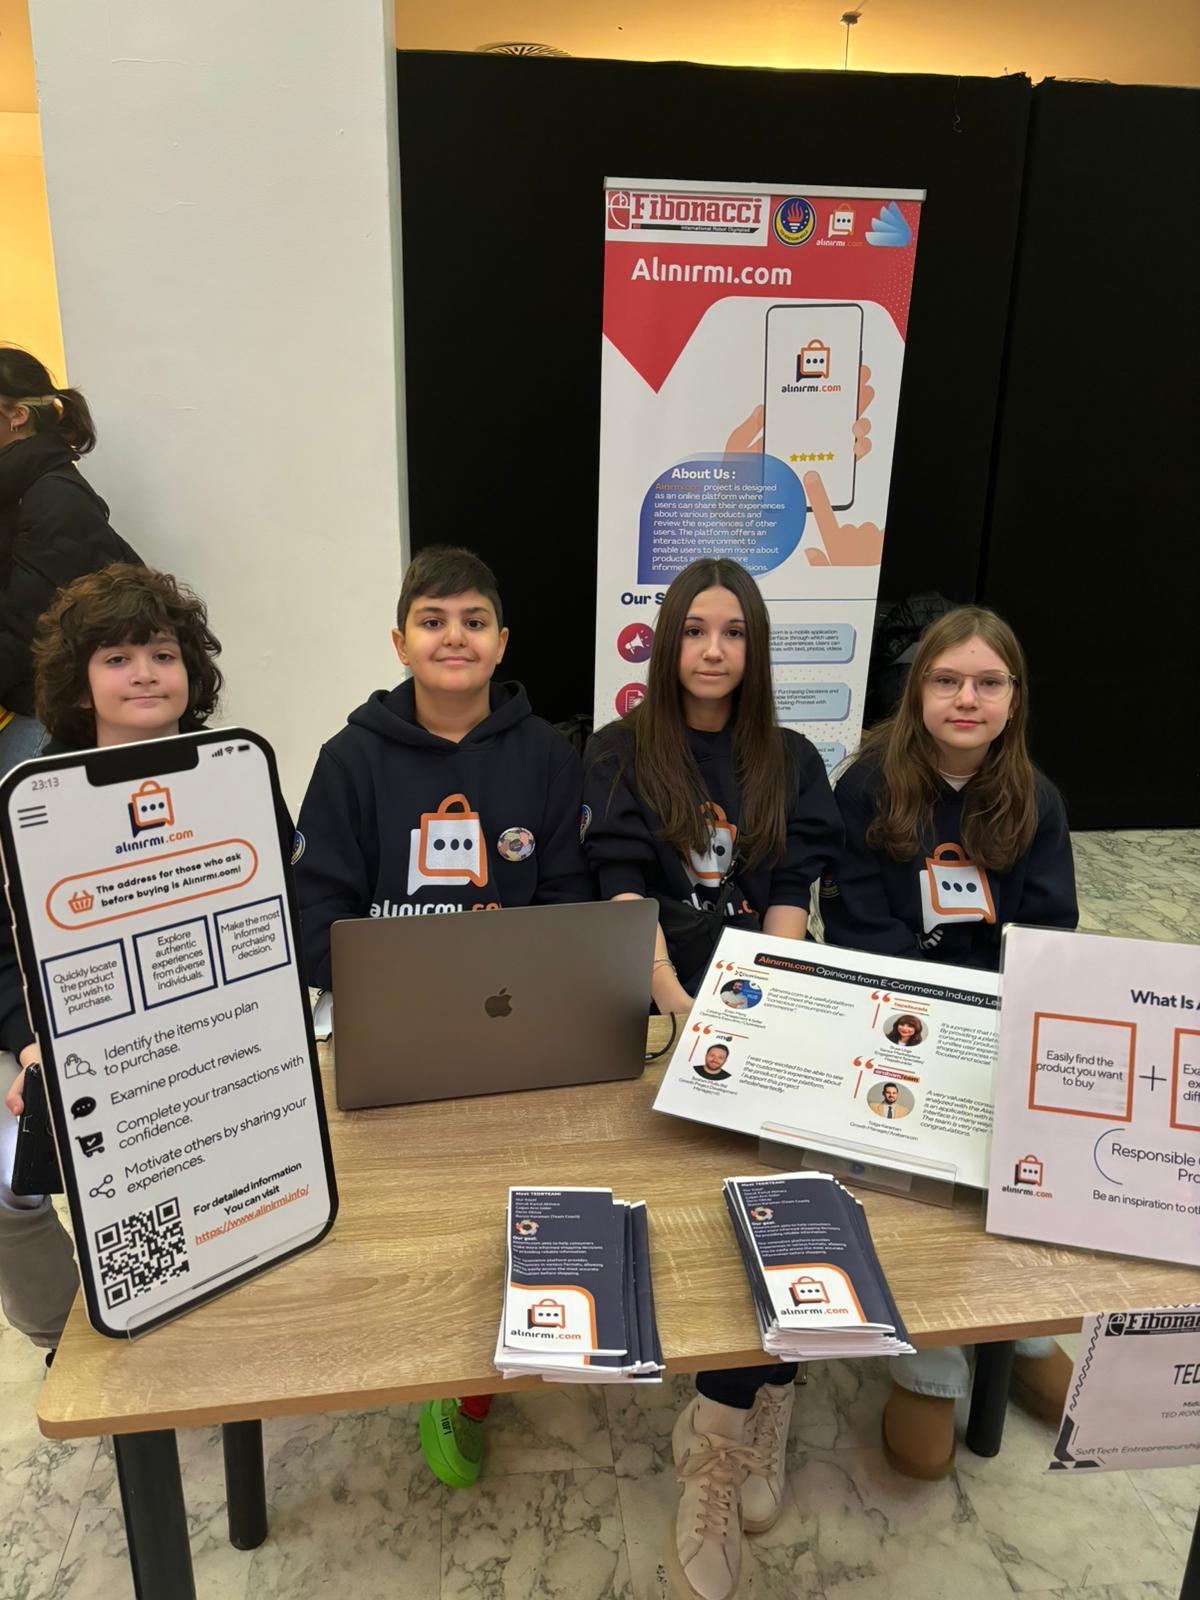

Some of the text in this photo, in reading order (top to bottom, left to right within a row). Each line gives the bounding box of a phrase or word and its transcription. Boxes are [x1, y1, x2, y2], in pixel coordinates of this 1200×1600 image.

[632, 193, 762, 224] Fibonacci
[672, 468, 710, 480] About
[701, 492, 736, 502] platform
[704, 484, 732, 493] project
[742, 484, 776, 494] designed
[710, 511, 746, 520] products
[738, 502, 784, 512] experiences
[694, 528, 729, 538] platform
[697, 520, 744, 530] experiences
[652, 556, 688, 565] products
[621, 592, 652, 605] Our
[32, 777, 60, 791] 23:13
[96, 852, 242, 894] The address for those who ask
[101, 895, 134, 907] before
[136, 885, 170, 899] buying
[172, 881, 180, 889] is
[221, 910, 280, 934] Make the most
[234, 924, 270, 941] informed
[156, 940, 197, 958] authentic
[158, 930, 191, 948] Explore
[231, 932, 276, 953] purchasing
[152, 950, 204, 971] experiences
[238, 945, 272, 960] decision.
[53, 960, 118, 986] Quickly locate
[152, 959, 206, 981] from diverse
[157, 971, 204, 990] individuals.
[60, 972, 114, 993] the product
[816, 966, 856, 982] Opinions
[858, 975, 878, 986] from
[880, 978, 944, 996] E-Commerce
[946, 990, 984, 1005] Industry
[64, 982, 114, 1005] you wish to
[1130, 989, 1177, 1008] What
[1181, 995, 1194, 1009] Is
[68, 994, 112, 1015] purchase.
[104, 1000, 259, 1060] Identify the items you plan
[104, 1042, 180, 1076] to purchase.
[1046, 1050, 1114, 1068] Easily find the
[110, 1044, 262, 1105] Examine product reviews.
[1036, 1062, 1123, 1080] product you want
[1062, 1076, 1094, 1091] to buy
[116, 1055, 304, 1134] Complete your transactions with
[118, 1112, 192, 1150] confidence.
[124, 1096, 308, 1178] Motivate others by sharing your
[1112, 1142, 1196, 1166] Responsible
[126, 1154, 206, 1194] experiences.
[193, 1162, 302, 1216] For detailed information
[224, 1185, 280, 1216] You can visit
[1093, 1189, 1107, 1201] Be
[1108, 1194, 1121, 1203] an
[1122, 1194, 1174, 1211] inspiration
[1176, 1203, 1186, 1213] to
